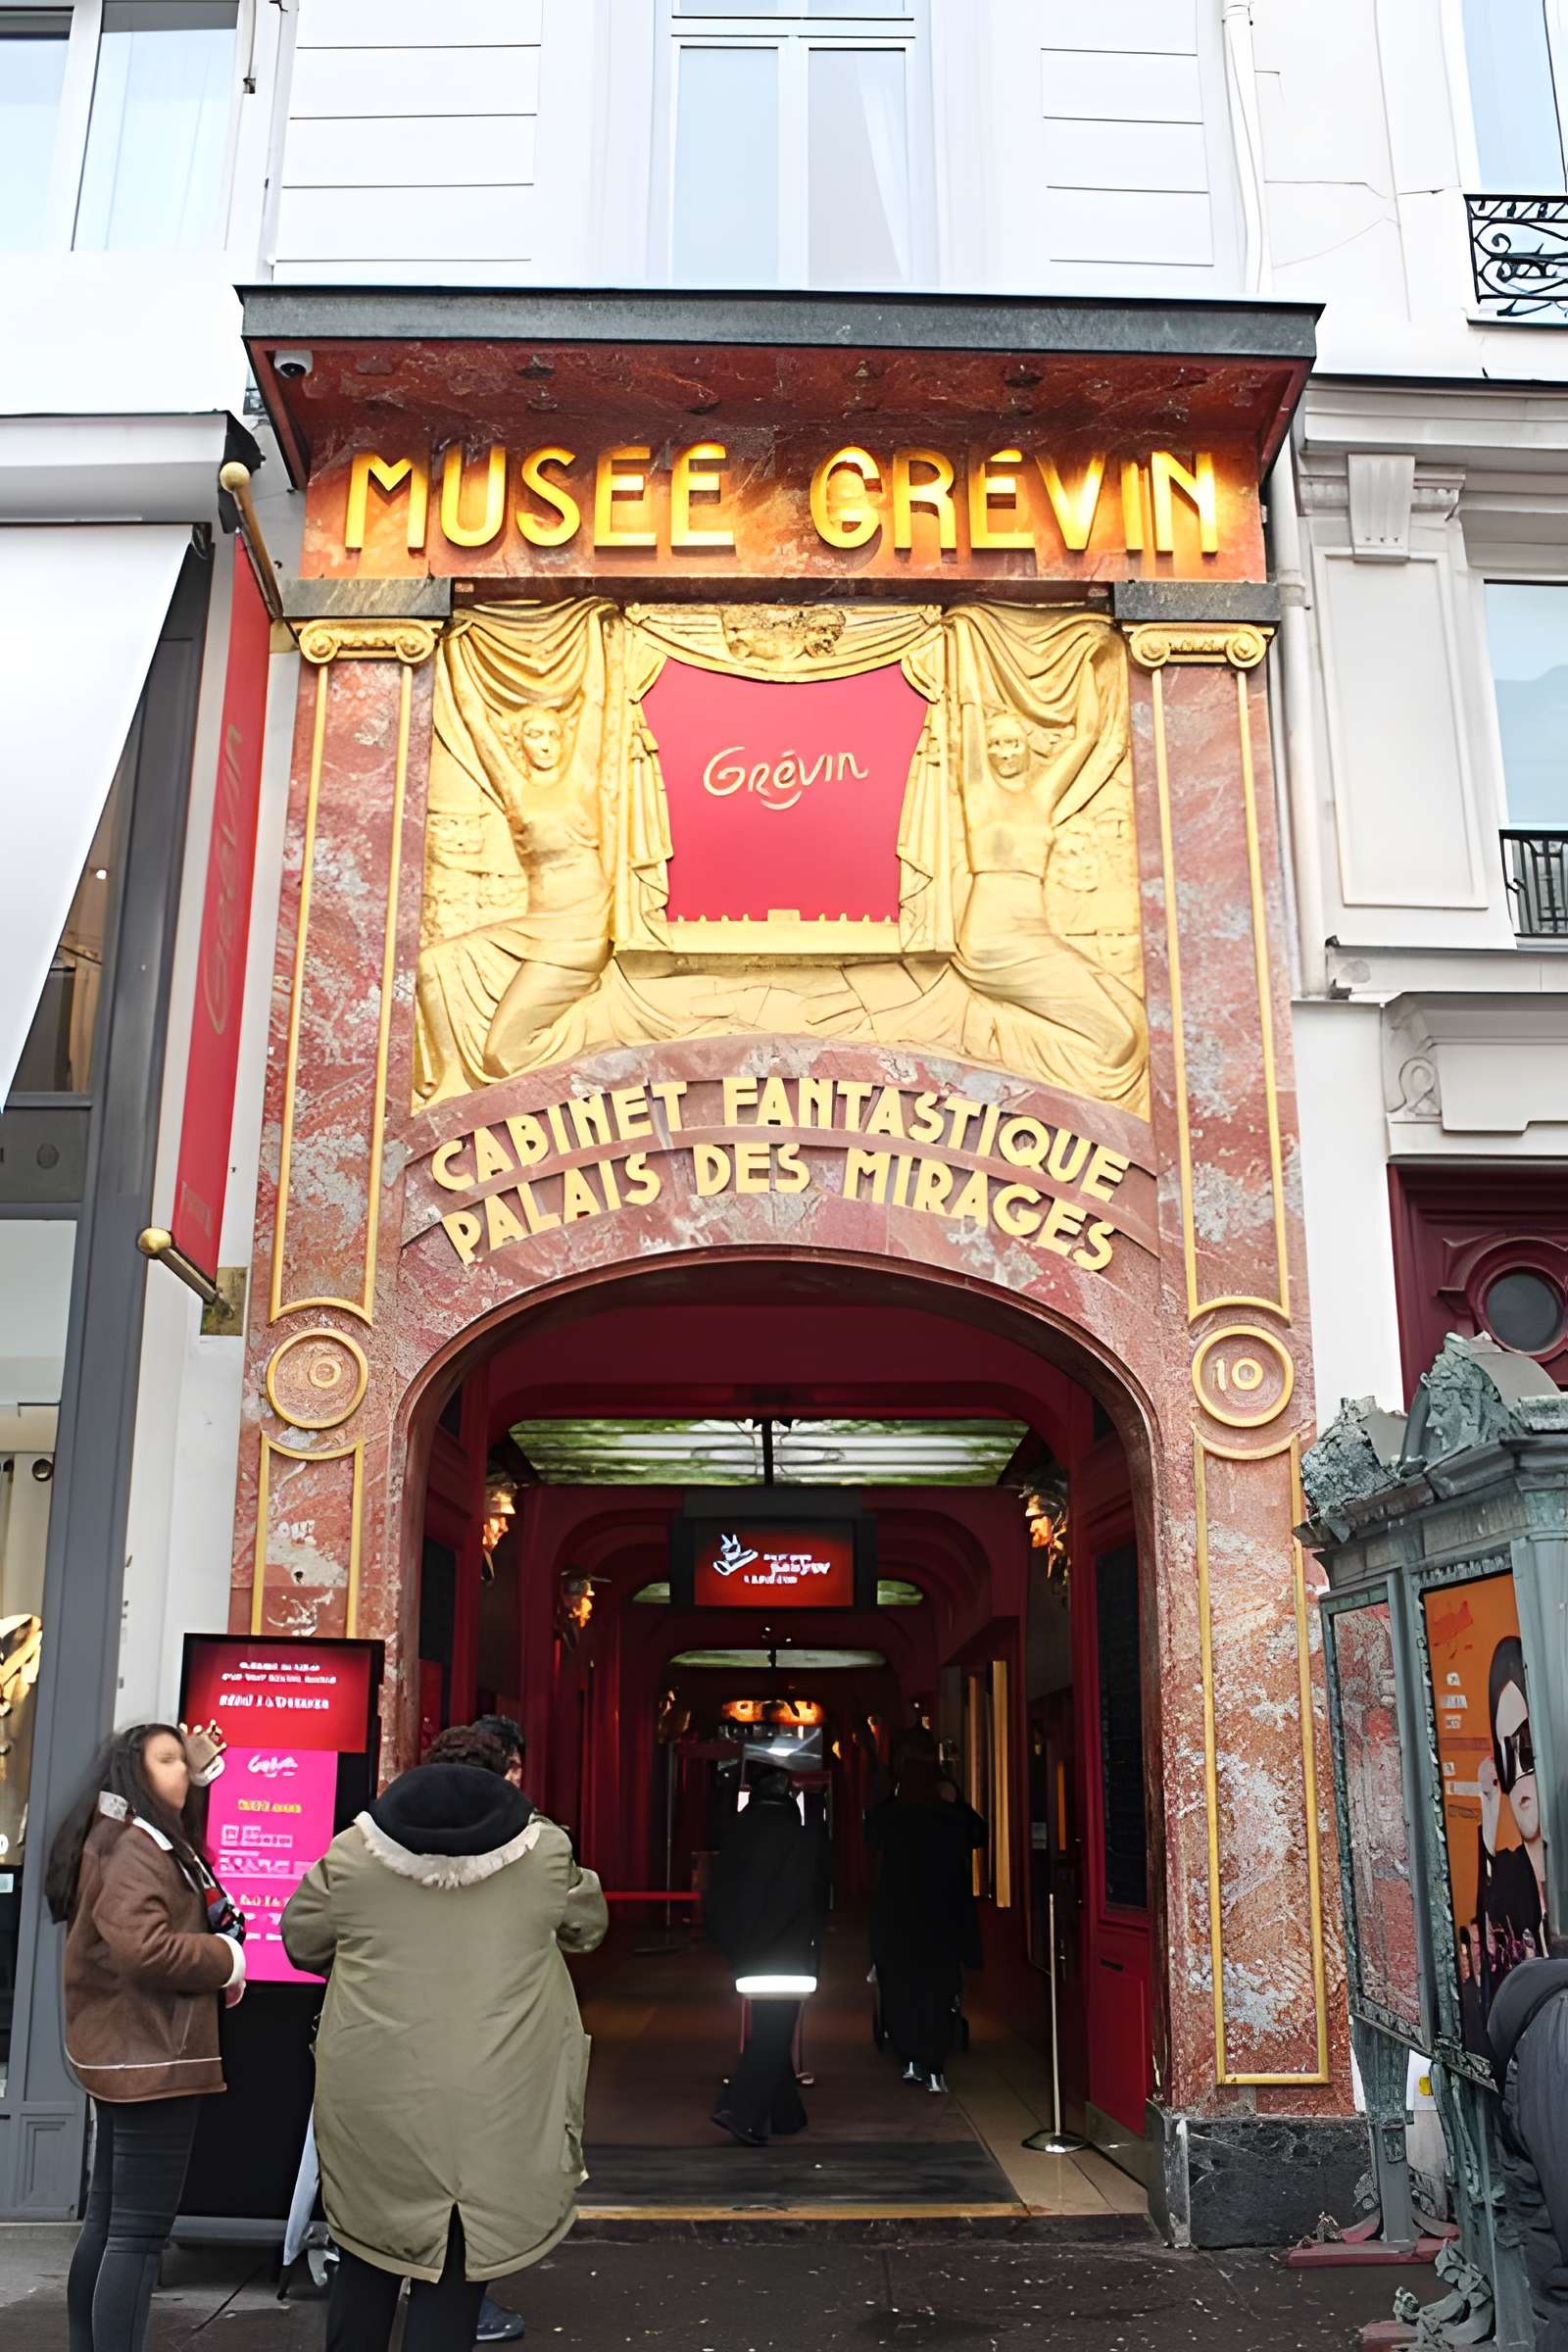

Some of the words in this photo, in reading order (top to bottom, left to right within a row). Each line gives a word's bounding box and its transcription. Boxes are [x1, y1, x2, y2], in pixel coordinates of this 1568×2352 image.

[430, 1081, 688, 1192] CABINET
[722, 1075, 1131, 1201] FANTASTIQUE
[439, 1153, 662, 1266] PALAIS
[693, 1142, 811, 1195] DES
[842, 1147, 1117, 1273] MIRAGES
[1215, 1356, 1264, 1392] 10
